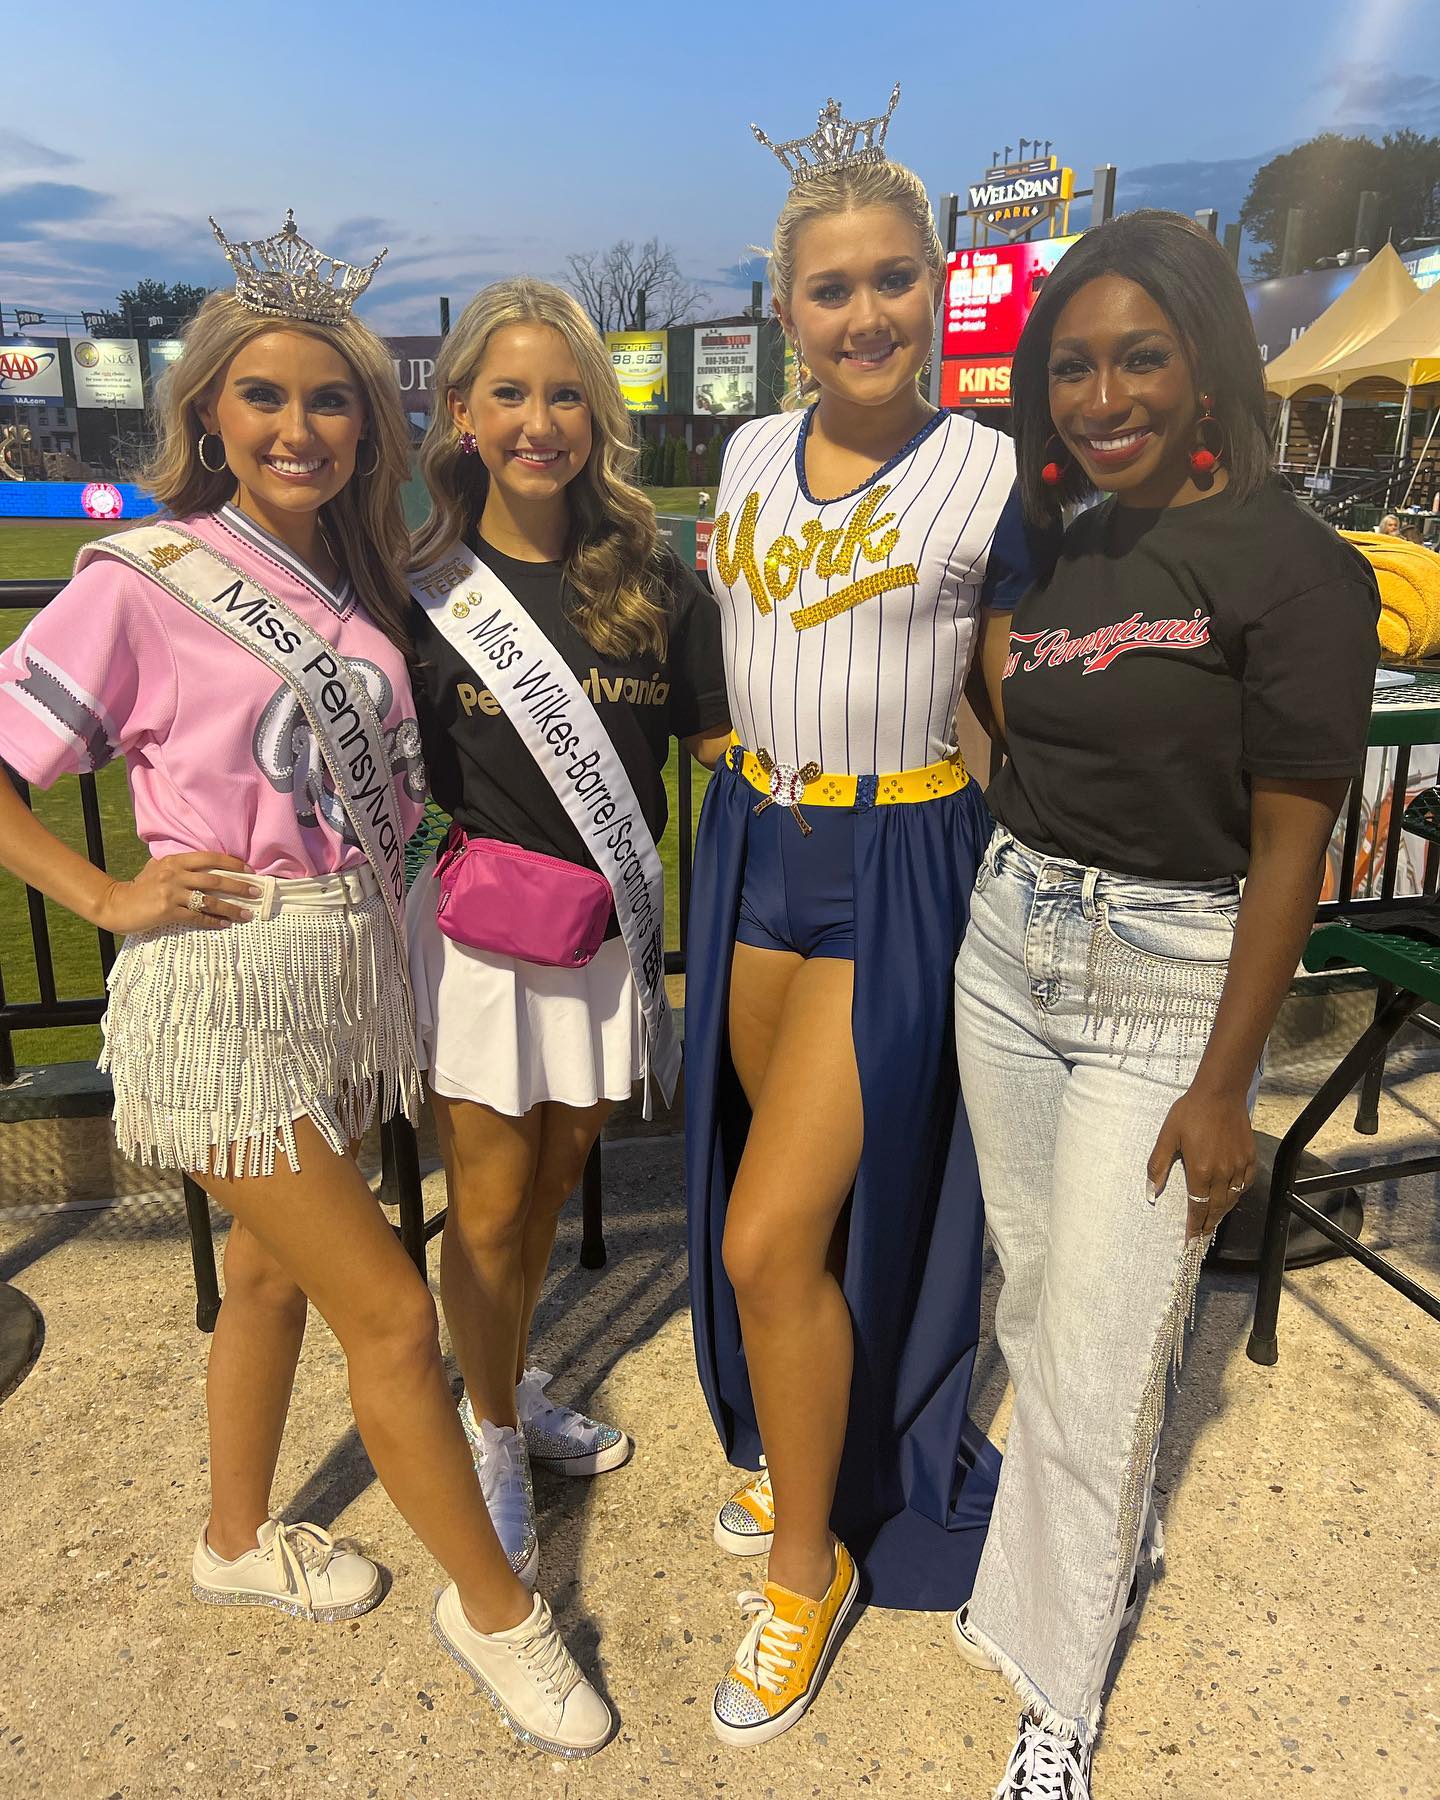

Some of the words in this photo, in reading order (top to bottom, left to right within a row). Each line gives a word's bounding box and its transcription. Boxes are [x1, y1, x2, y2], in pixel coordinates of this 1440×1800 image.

[995, 206, 1030, 221] PARK
[19, 314, 39, 324] 2010
[86, 316, 106, 326] 2011
[612, 344, 651, 352] SPORTS
[0, 354, 33, 379] AAA
[104, 354, 135, 364] NECA
[612, 355, 645, 365] 98.9
[645, 354, 662, 364] FM
[713, 484, 901, 617] York
[420, 562, 474, 600] TEEN
[211, 580, 302, 654] Miss
[301, 650, 403, 907] Pennsylvania
[467, 608, 524, 670] Miss
[512, 659, 657, 939] Wilkes-Barre/Scranton's
